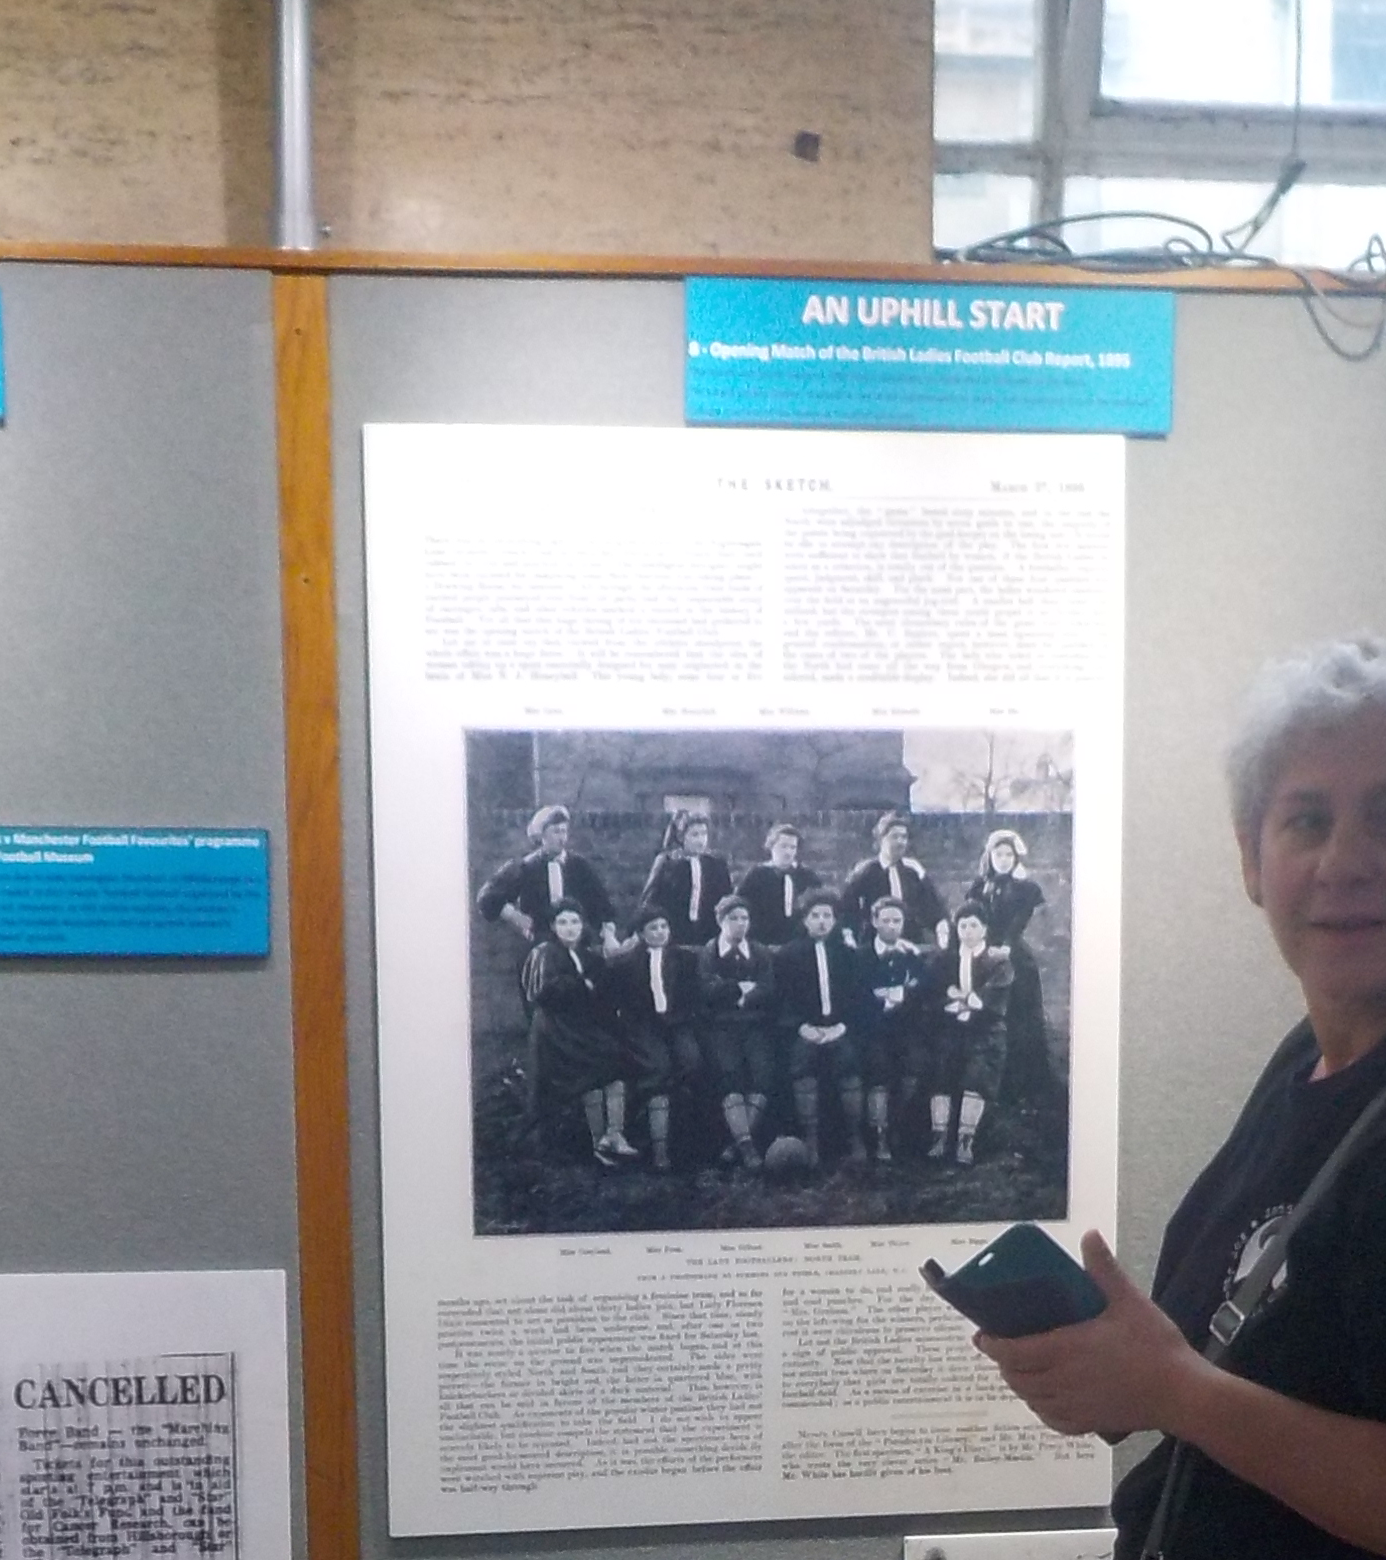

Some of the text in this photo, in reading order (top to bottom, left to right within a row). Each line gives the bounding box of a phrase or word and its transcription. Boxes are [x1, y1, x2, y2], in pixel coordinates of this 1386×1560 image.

[802, 295, 1066, 332] AN UPHILL START
[710, 342, 769, 361] Opening
[771, 343, 815, 359] Match
[818, 345, 834, 360] of
[836, 345, 859, 360] the
[862, 346, 907, 362] British
[909, 348, 952, 363] Ladies
[954, 349, 1010, 365] Football
[1012, 350, 1043, 366] Club
[1045, 352, 1095, 369] Report,
[717, 478, 749, 491] THE
[4, 835, 11, 845] v
[13, 833, 80, 846] Manchester
[82, 834, 129, 847] Football
[194, 836, 260, 850] programme
[44, 852, 94, 864] Museum
[13, 1373, 227, 1410] CANCELLED
